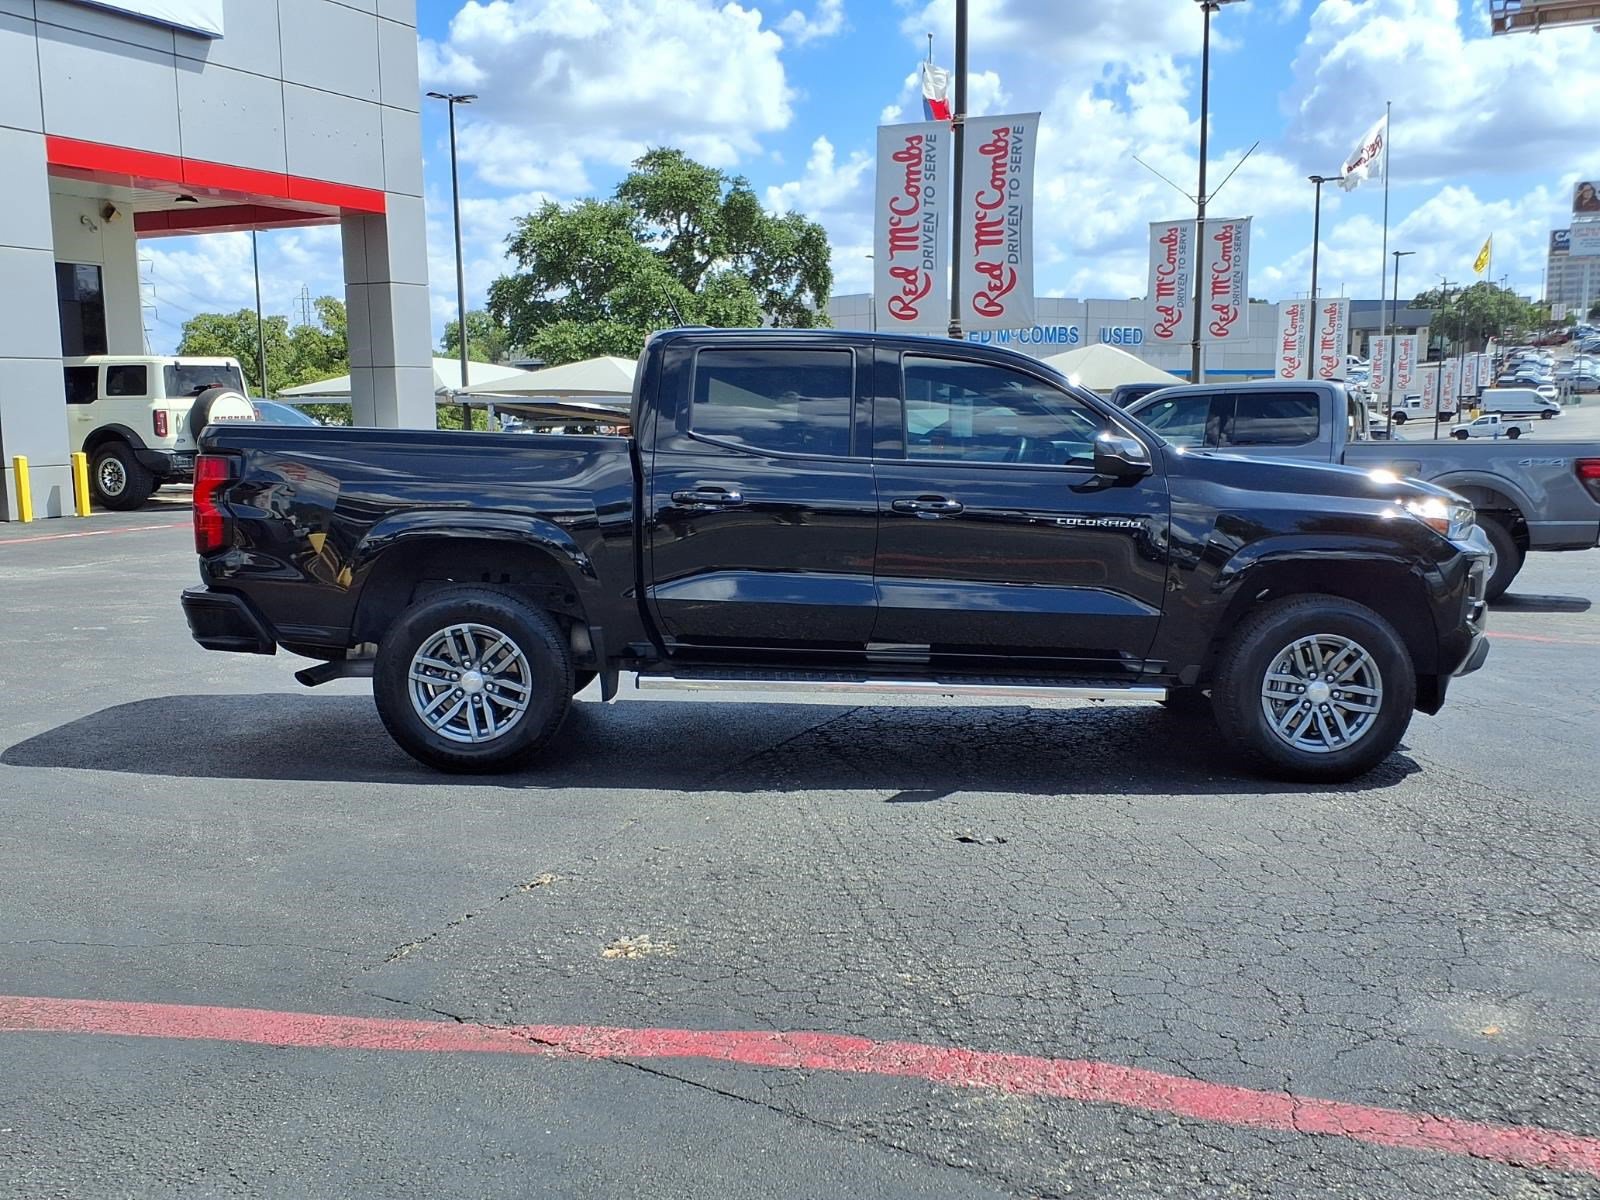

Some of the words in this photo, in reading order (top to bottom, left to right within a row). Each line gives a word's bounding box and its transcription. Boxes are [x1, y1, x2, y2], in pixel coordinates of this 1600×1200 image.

[924, 134, 937, 181] SERVE
[1009, 125, 1025, 173] SERVE
[888, 133, 923, 261] McCombs
[923, 185, 936, 207] TO
[974, 127, 1010, 257] McCombs
[1008, 179, 1020, 200] TO
[922, 211, 935, 270] DRIVEN
[1008, 204, 1019, 264] DRIVEN
[1178, 227, 1187, 255] SERVE
[1234, 223, 1243, 253] SERVE
[1156, 227, 1178, 303] McCombs
[1177, 257, 1186, 271] TO
[1211, 224, 1234, 301] McCombs
[1233, 255, 1241, 268] TO
[888, 266, 932, 320] Red
[972, 261, 1017, 317] Red
[1177, 273, 1185, 308] DRIVEN
[1232, 270, 1241, 306] DRIVEN
[996, 327, 1079, 344] McCOMBS
[1102, 328, 1143, 344] USED
[1154, 305, 1182, 338] Red
[1209, 303, 1238, 337] Red
[1281, 356, 1301, 378] Red
[1319, 355, 1340, 377] Red
[1056, 518, 1141, 528] COLORADO
